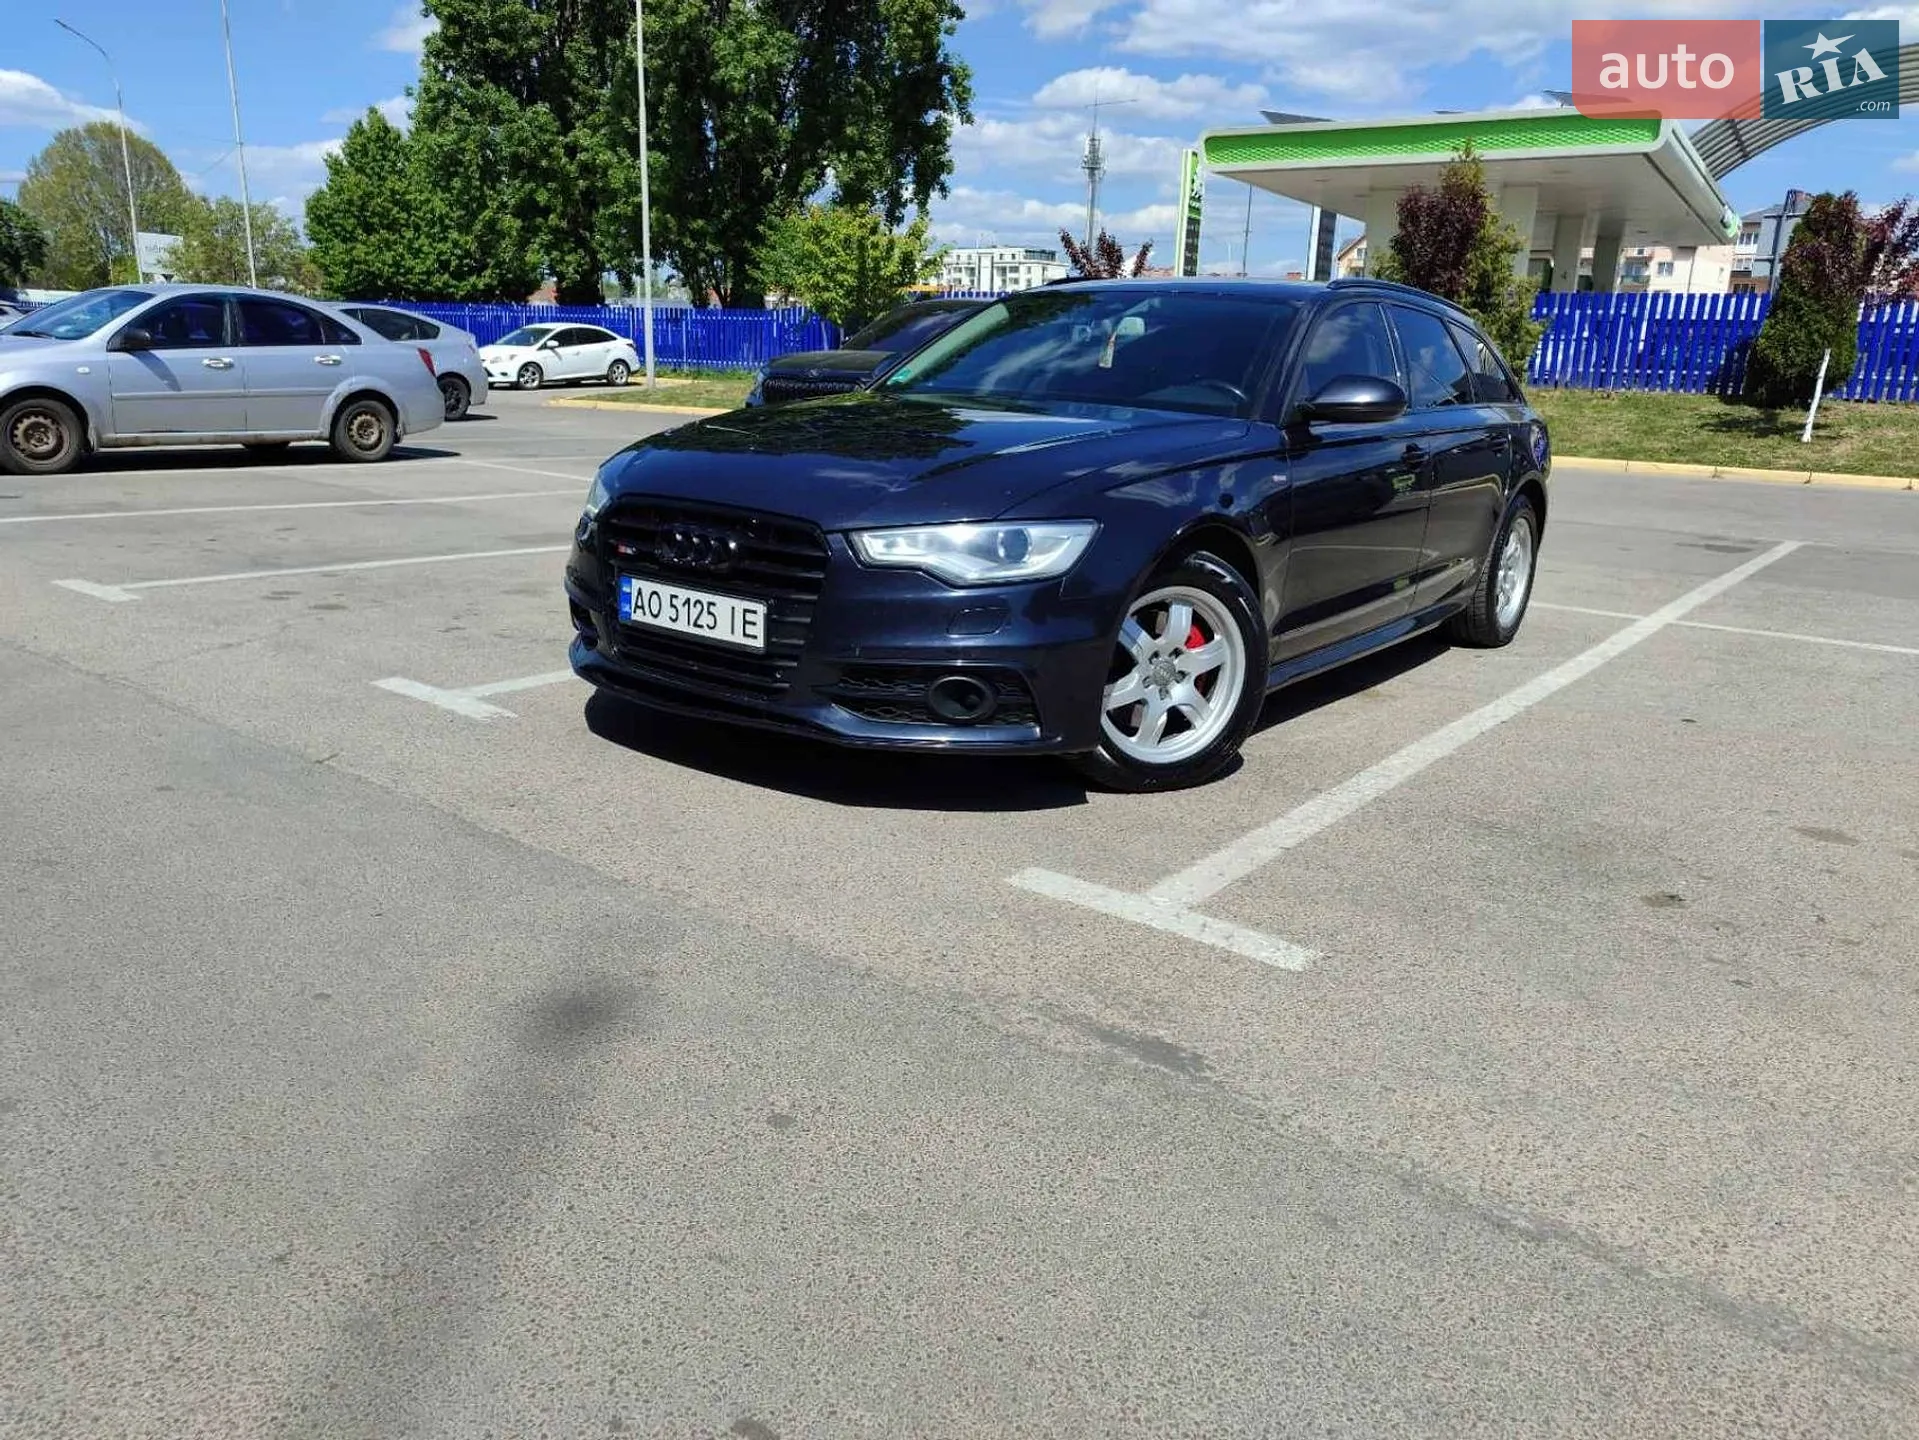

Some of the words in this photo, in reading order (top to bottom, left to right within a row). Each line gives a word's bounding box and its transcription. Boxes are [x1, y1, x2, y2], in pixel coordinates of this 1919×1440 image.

[633, 586, 662, 619] AO
[668, 593, 717, 630] 5125
[730, 605, 758, 640] IE
